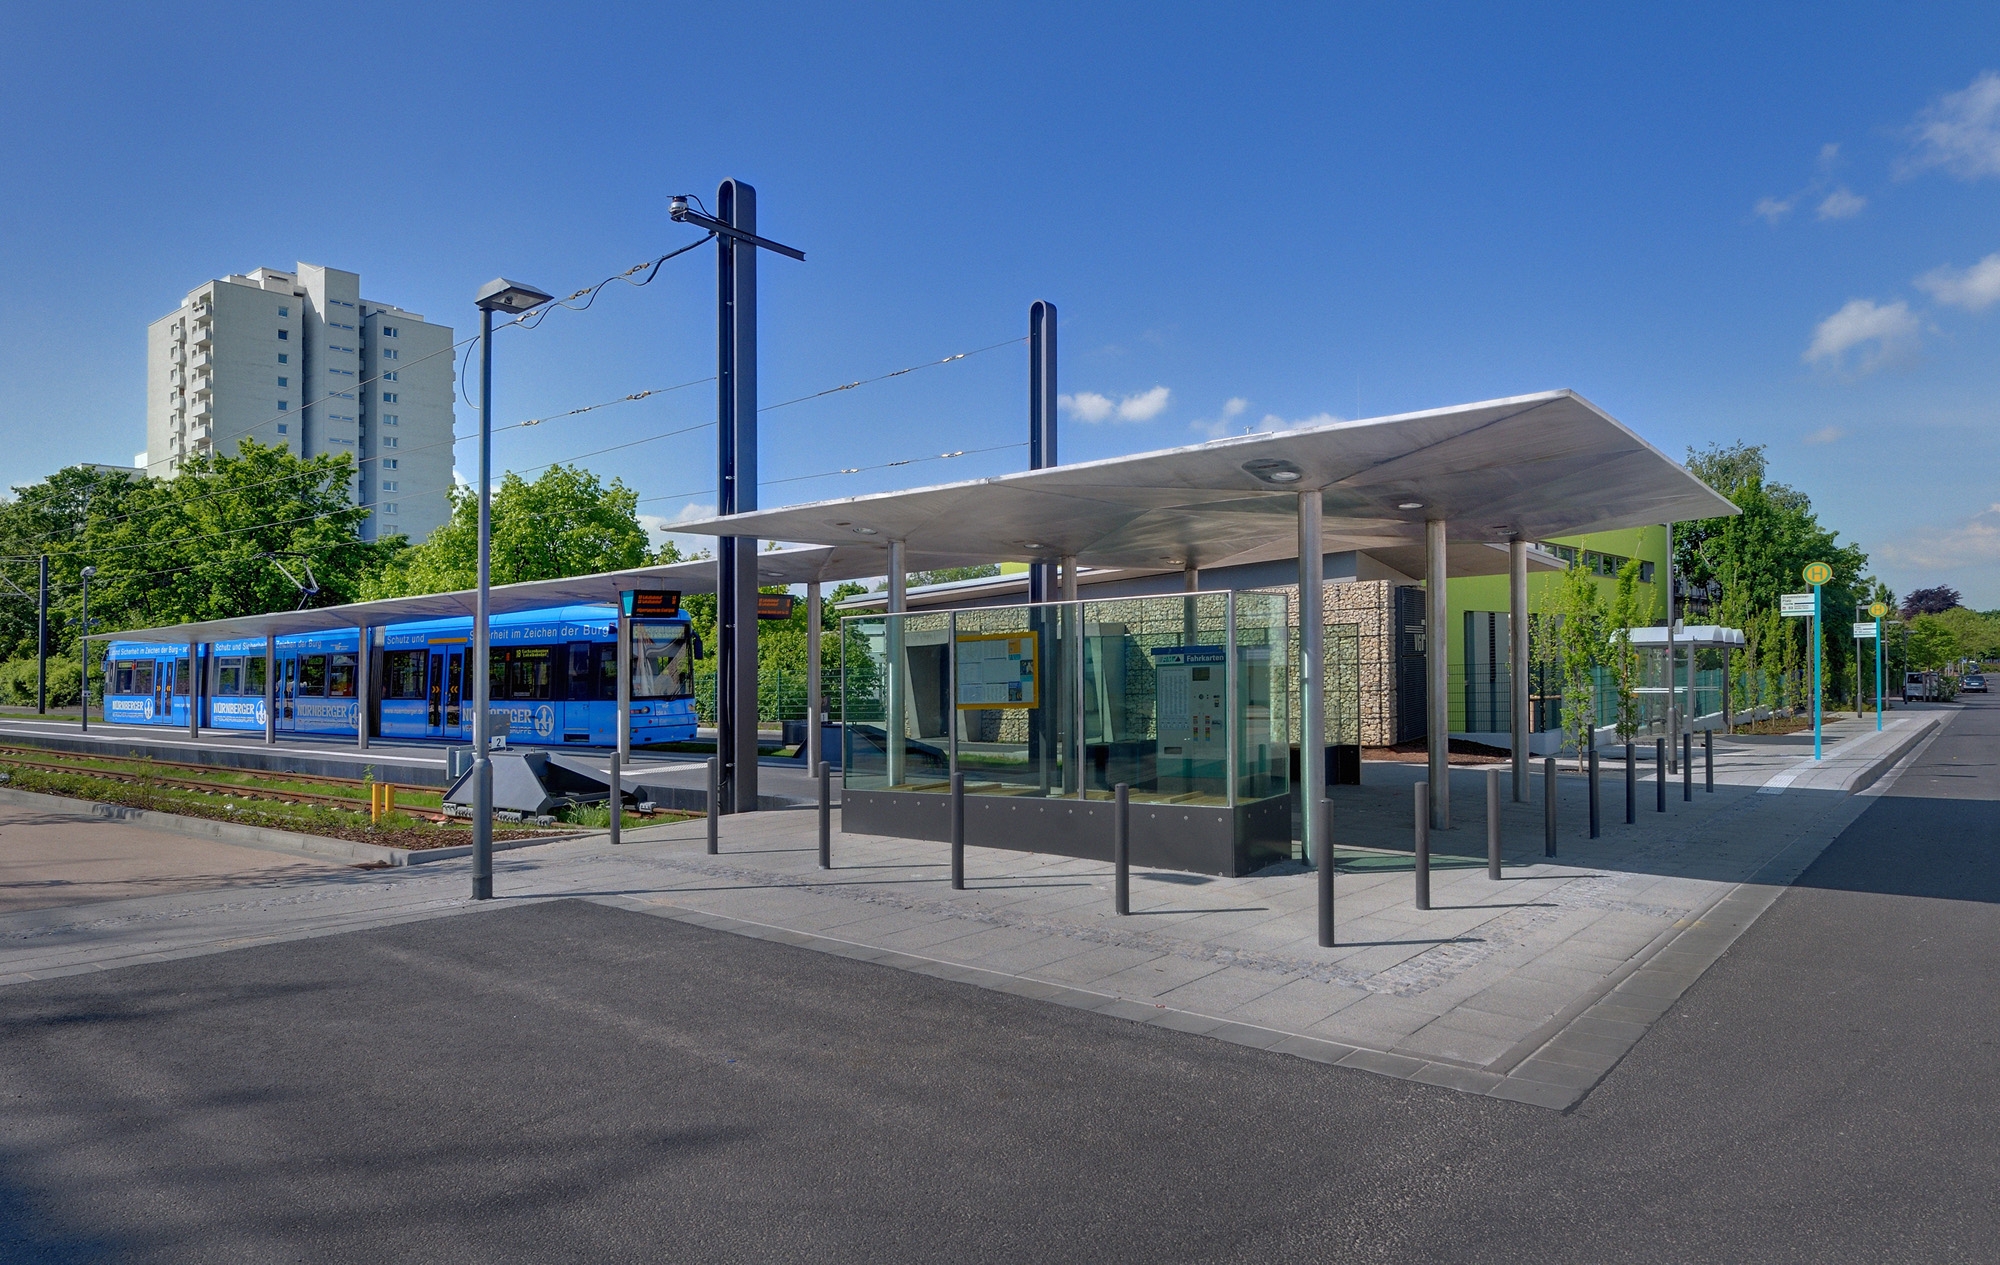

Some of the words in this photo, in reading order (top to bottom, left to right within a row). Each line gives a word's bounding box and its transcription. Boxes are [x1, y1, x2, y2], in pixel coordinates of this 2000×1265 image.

[1811, 567, 1823, 580] H
[512, 630, 521, 638] im
[524, 628, 558, 638] Zeichen
[561, 626, 579, 636] der
[583, 624, 610, 638] Burg
[308, 639, 322, 650] Burg
[386, 634, 410, 644] Schutz
[411, 634, 425, 643] und
[145, 646, 160, 654] Zeichen
[169, 646, 178, 654] Burg
[216, 642, 231, 652] Schutz
[232, 642, 242, 650] und
[112, 700, 144, 711] NÜRNBERGER
[214, 702, 255, 714] NÜRNBERGER
[297, 704, 347, 718] NÜRNBERGER
[496, 738, 502, 747] 2
